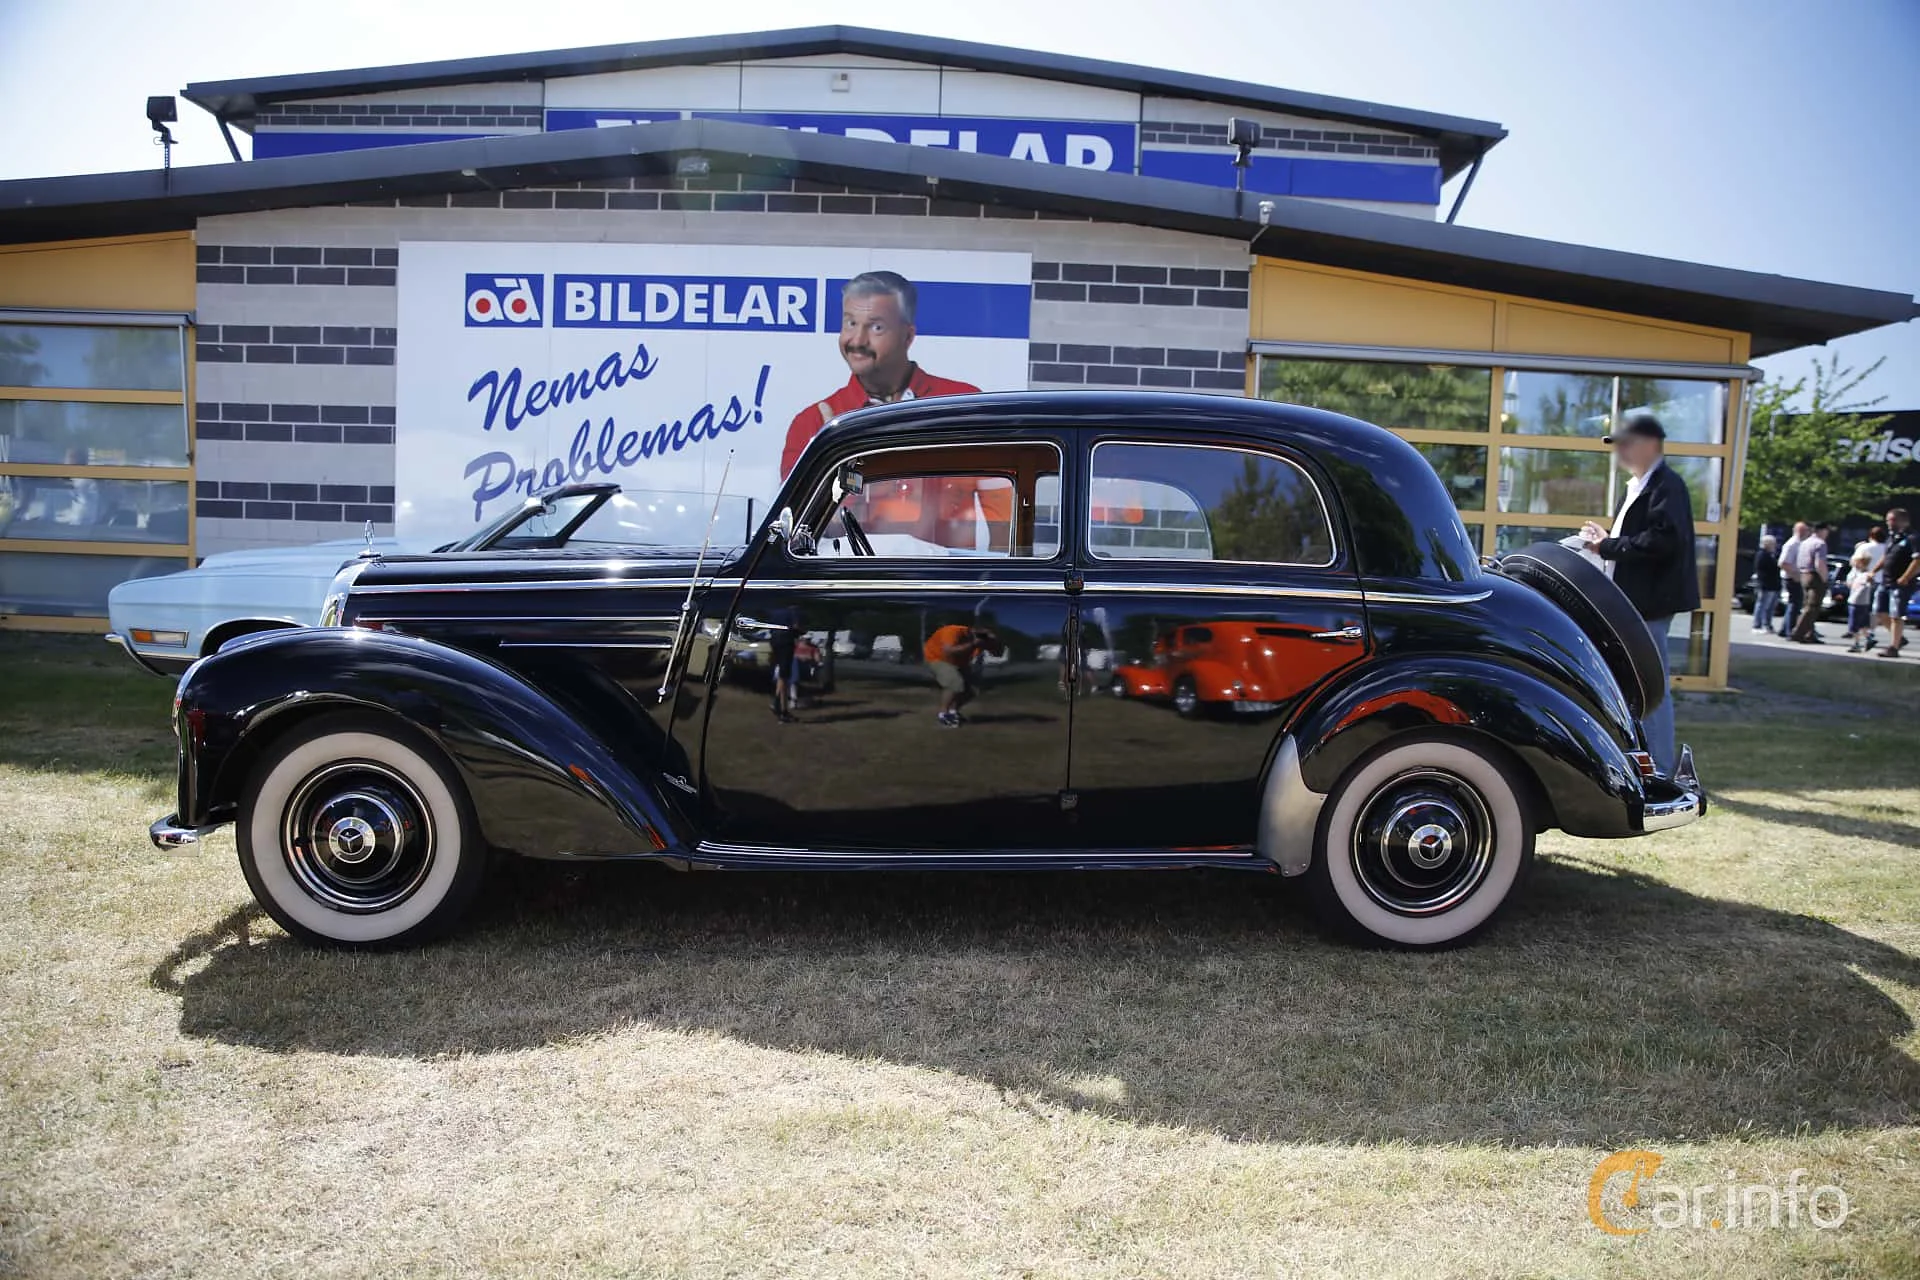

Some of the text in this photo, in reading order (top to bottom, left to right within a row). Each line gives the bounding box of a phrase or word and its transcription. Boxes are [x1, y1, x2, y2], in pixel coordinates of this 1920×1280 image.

[564, 281, 809, 326] BILDELAR
[467, 343, 659, 431] Nemas
[463, 364, 771, 523] Problemas!
